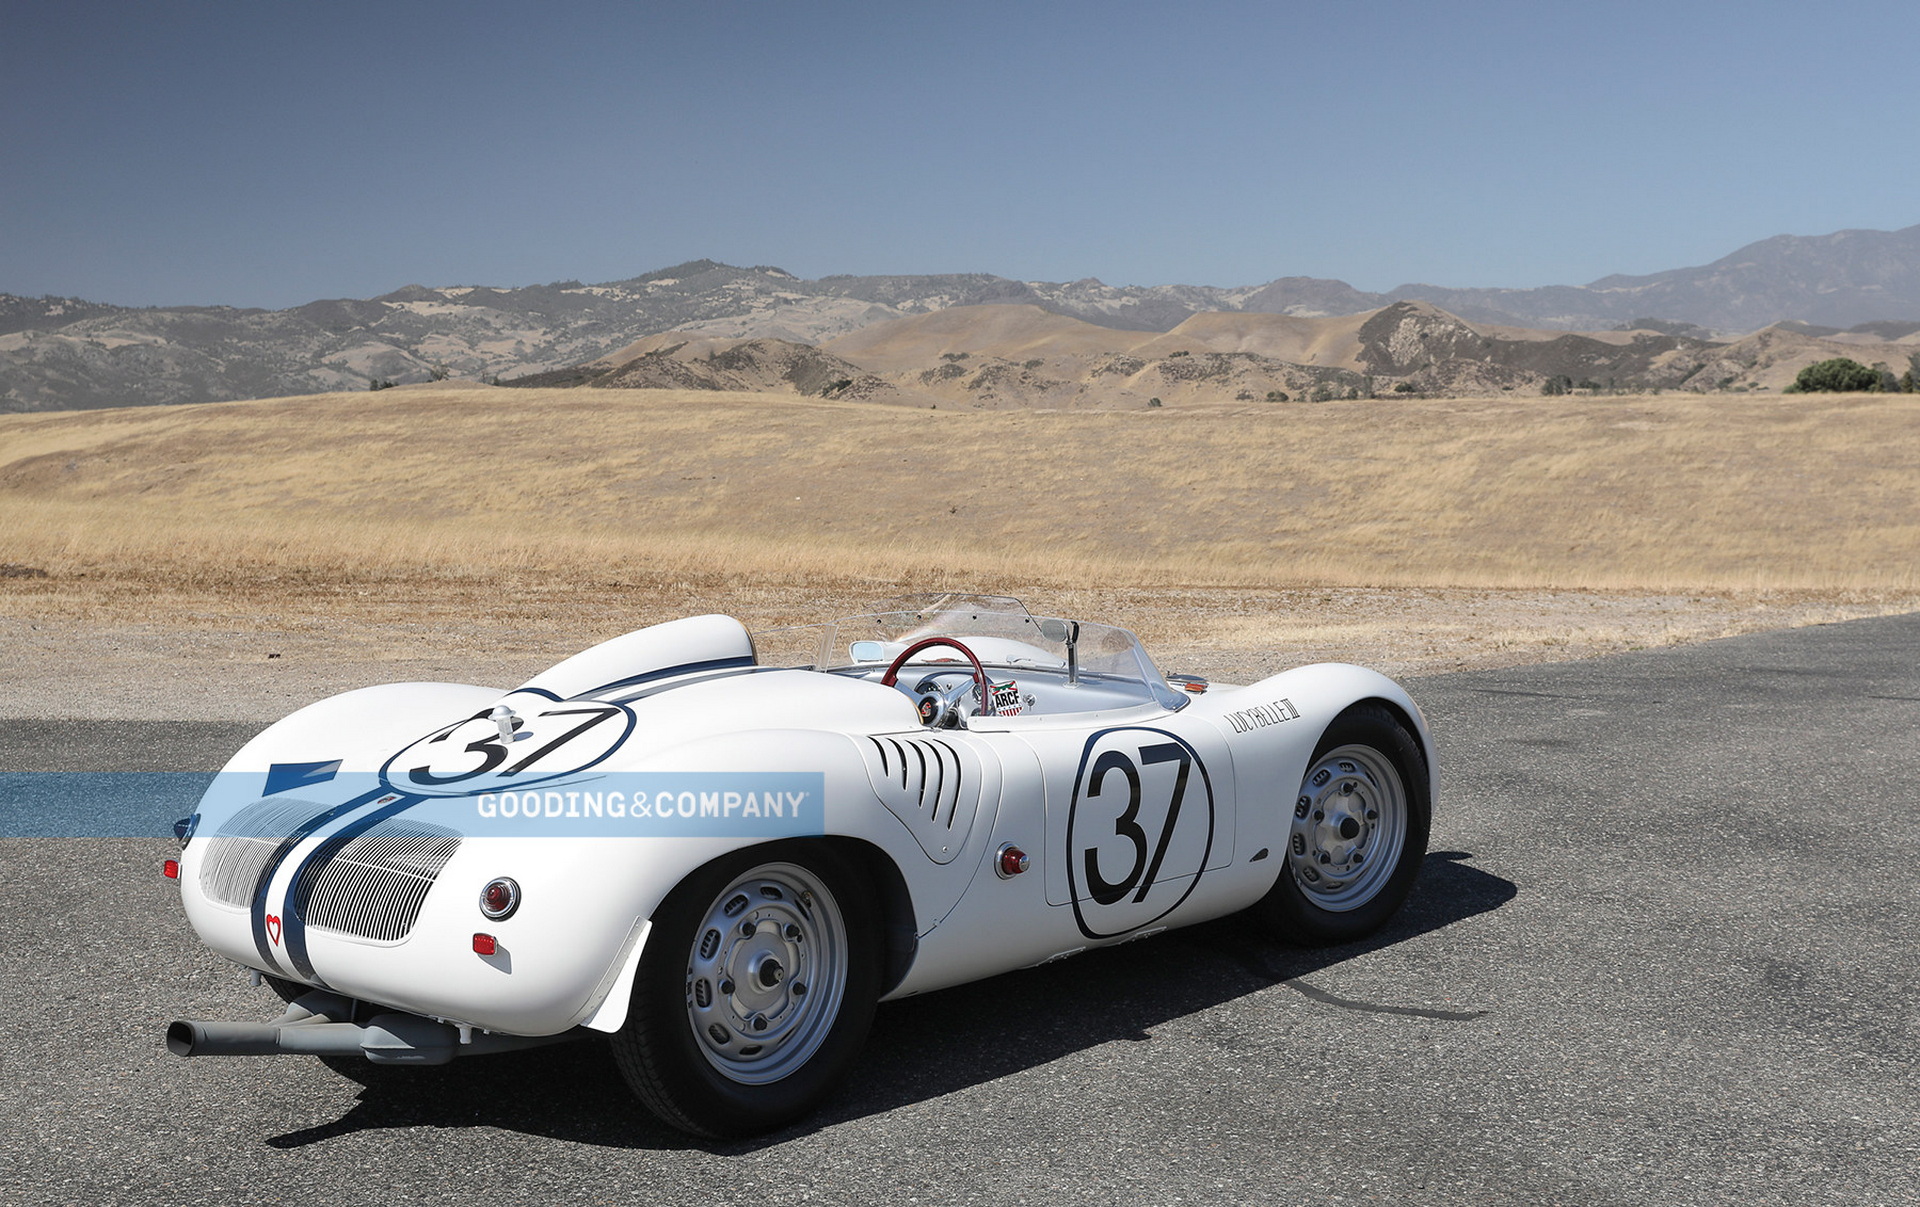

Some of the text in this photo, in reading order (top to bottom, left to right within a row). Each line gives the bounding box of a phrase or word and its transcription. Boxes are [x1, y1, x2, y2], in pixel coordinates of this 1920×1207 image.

[995, 690, 1020, 708] ARCF
[409, 707, 621, 786] 37
[1084, 742, 1192, 906] 37
